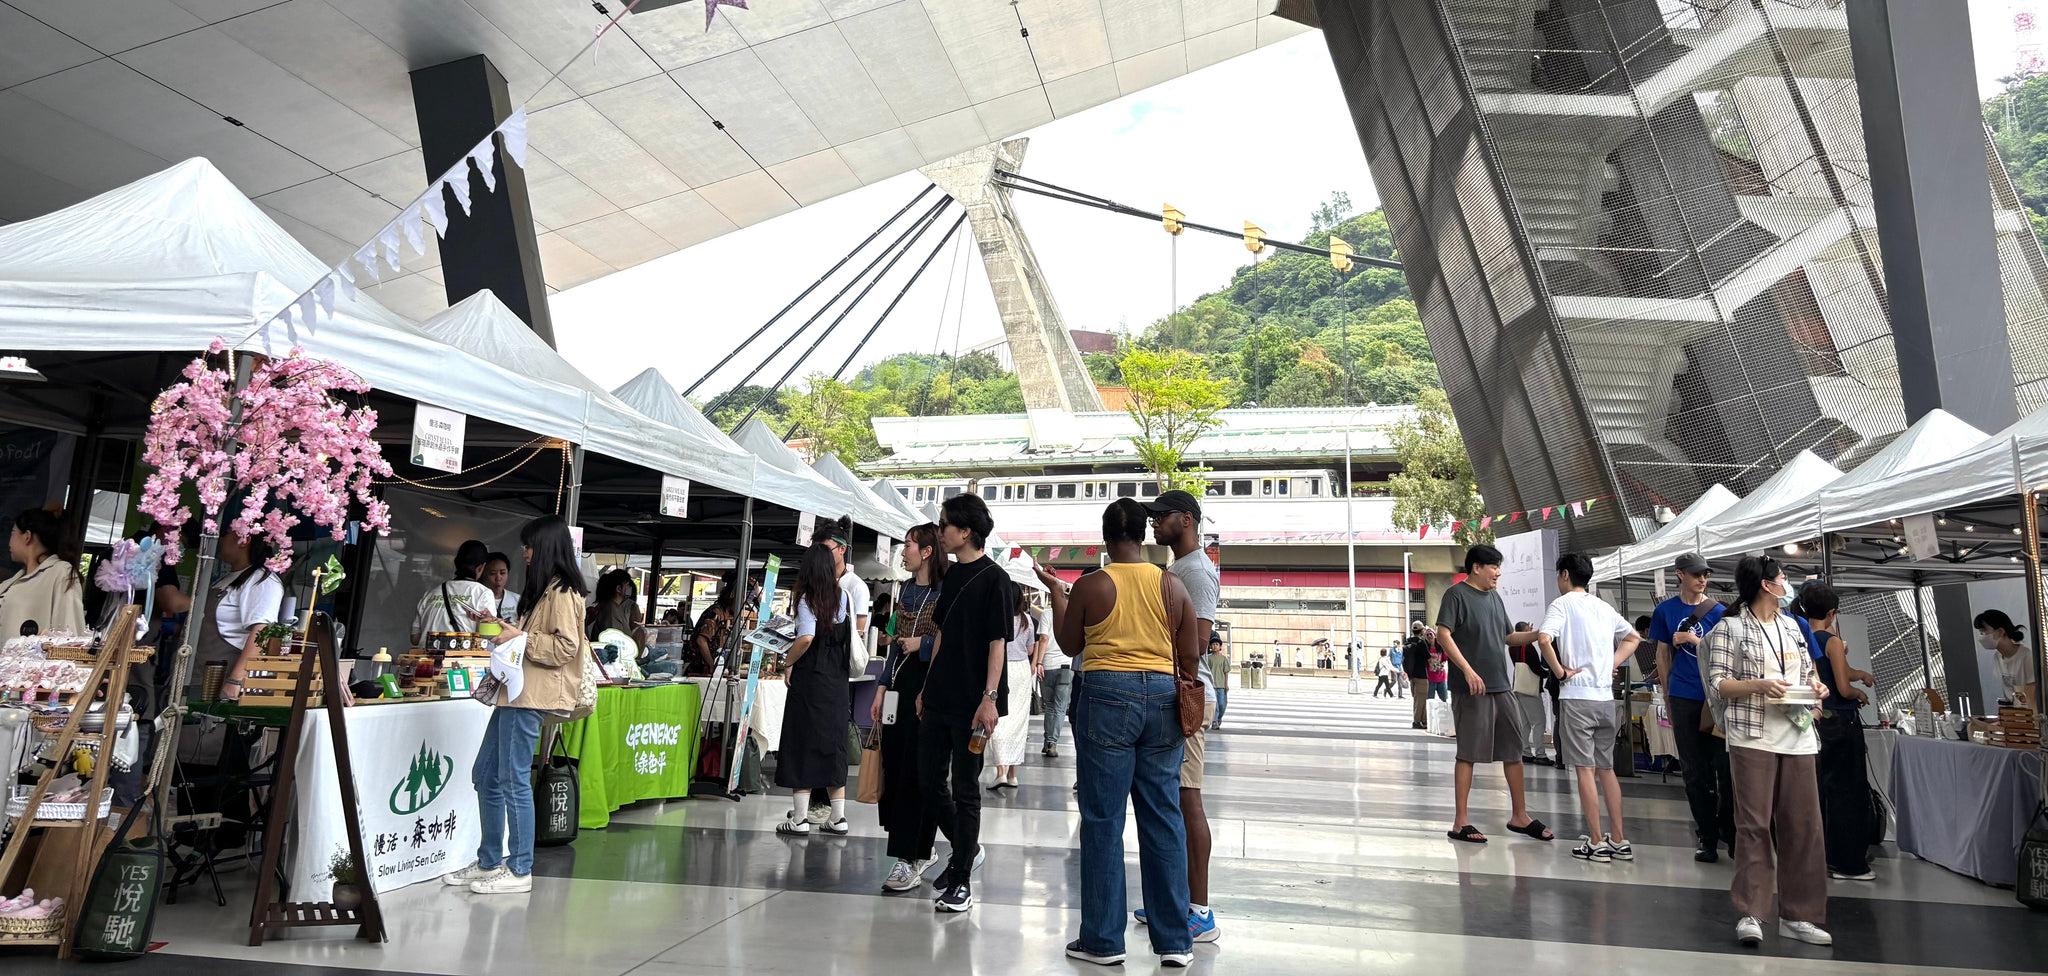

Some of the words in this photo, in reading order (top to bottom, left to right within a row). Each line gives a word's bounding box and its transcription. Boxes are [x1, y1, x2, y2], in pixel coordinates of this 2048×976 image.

[549, 781, 568, 793] YES
[2028, 846, 2048, 859] YES
[378, 863, 396, 878] Slow
[397, 859, 415, 872] Living
[415, 855, 429, 867] Sen
[430, 849, 446, 864] Coffee
[121, 865, 152, 881] YES
